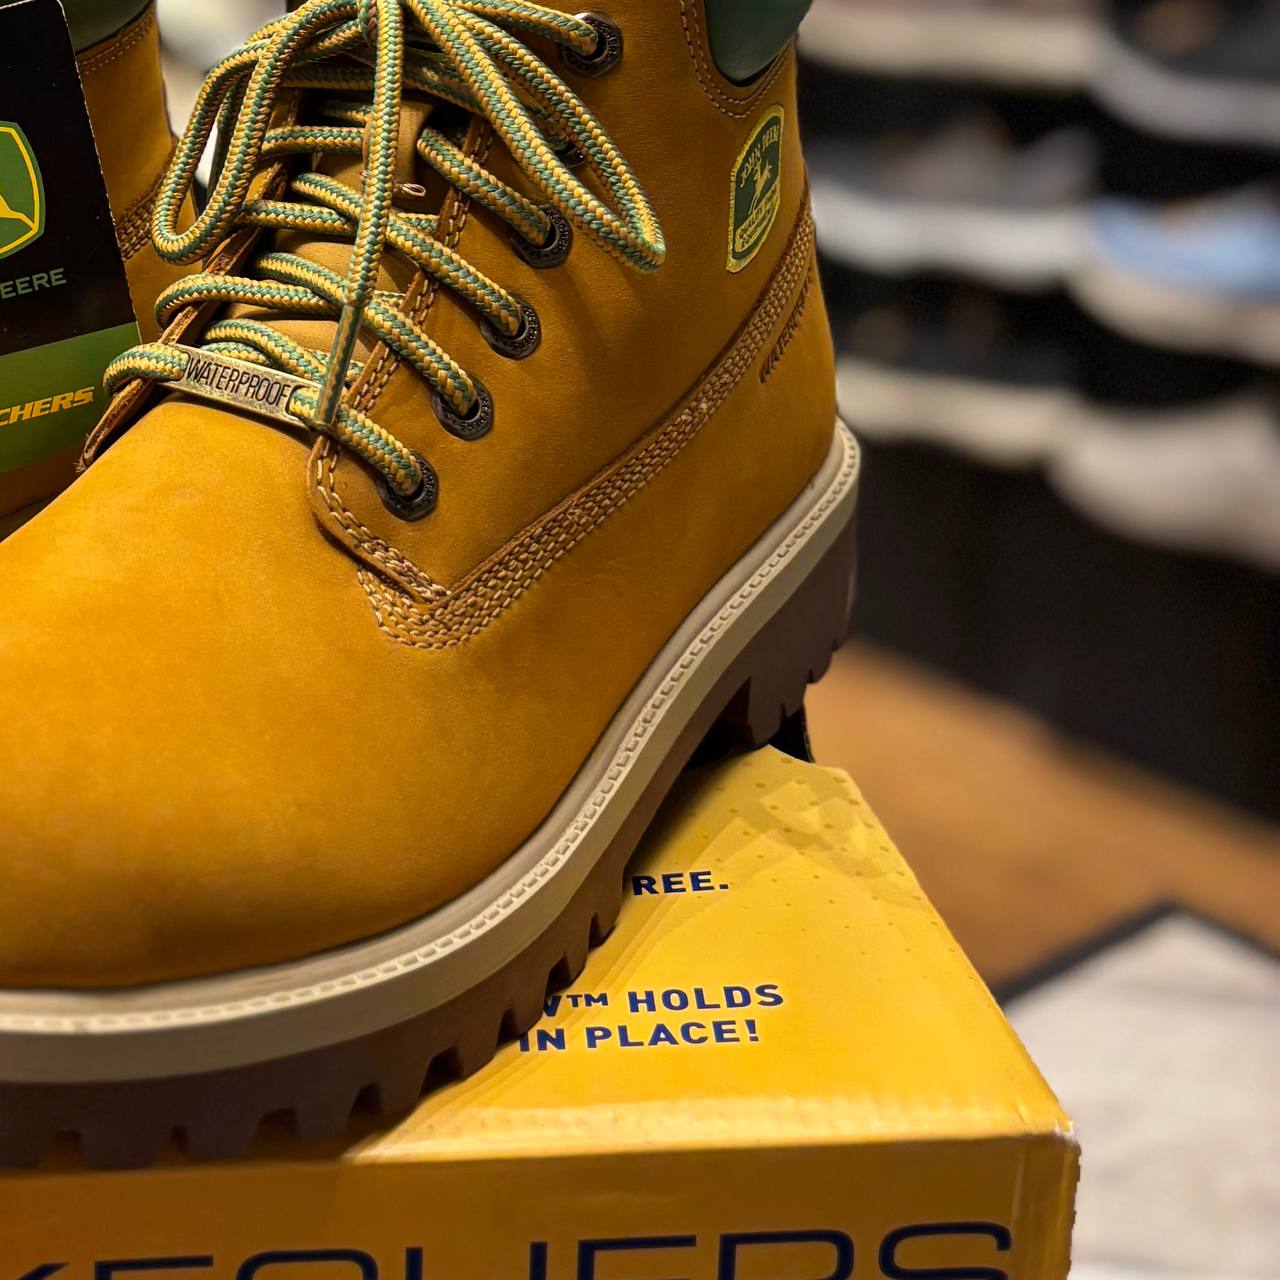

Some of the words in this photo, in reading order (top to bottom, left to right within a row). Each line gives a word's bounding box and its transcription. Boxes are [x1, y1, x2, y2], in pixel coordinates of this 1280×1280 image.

[186, 357, 291, 407] WATERPROOF
[631, 870, 729, 896] REE.
[627, 984, 784, 1013] HOLDS
[519, 1028, 566, 1052] IN
[586, 1019, 760, 1049] PLACE!
